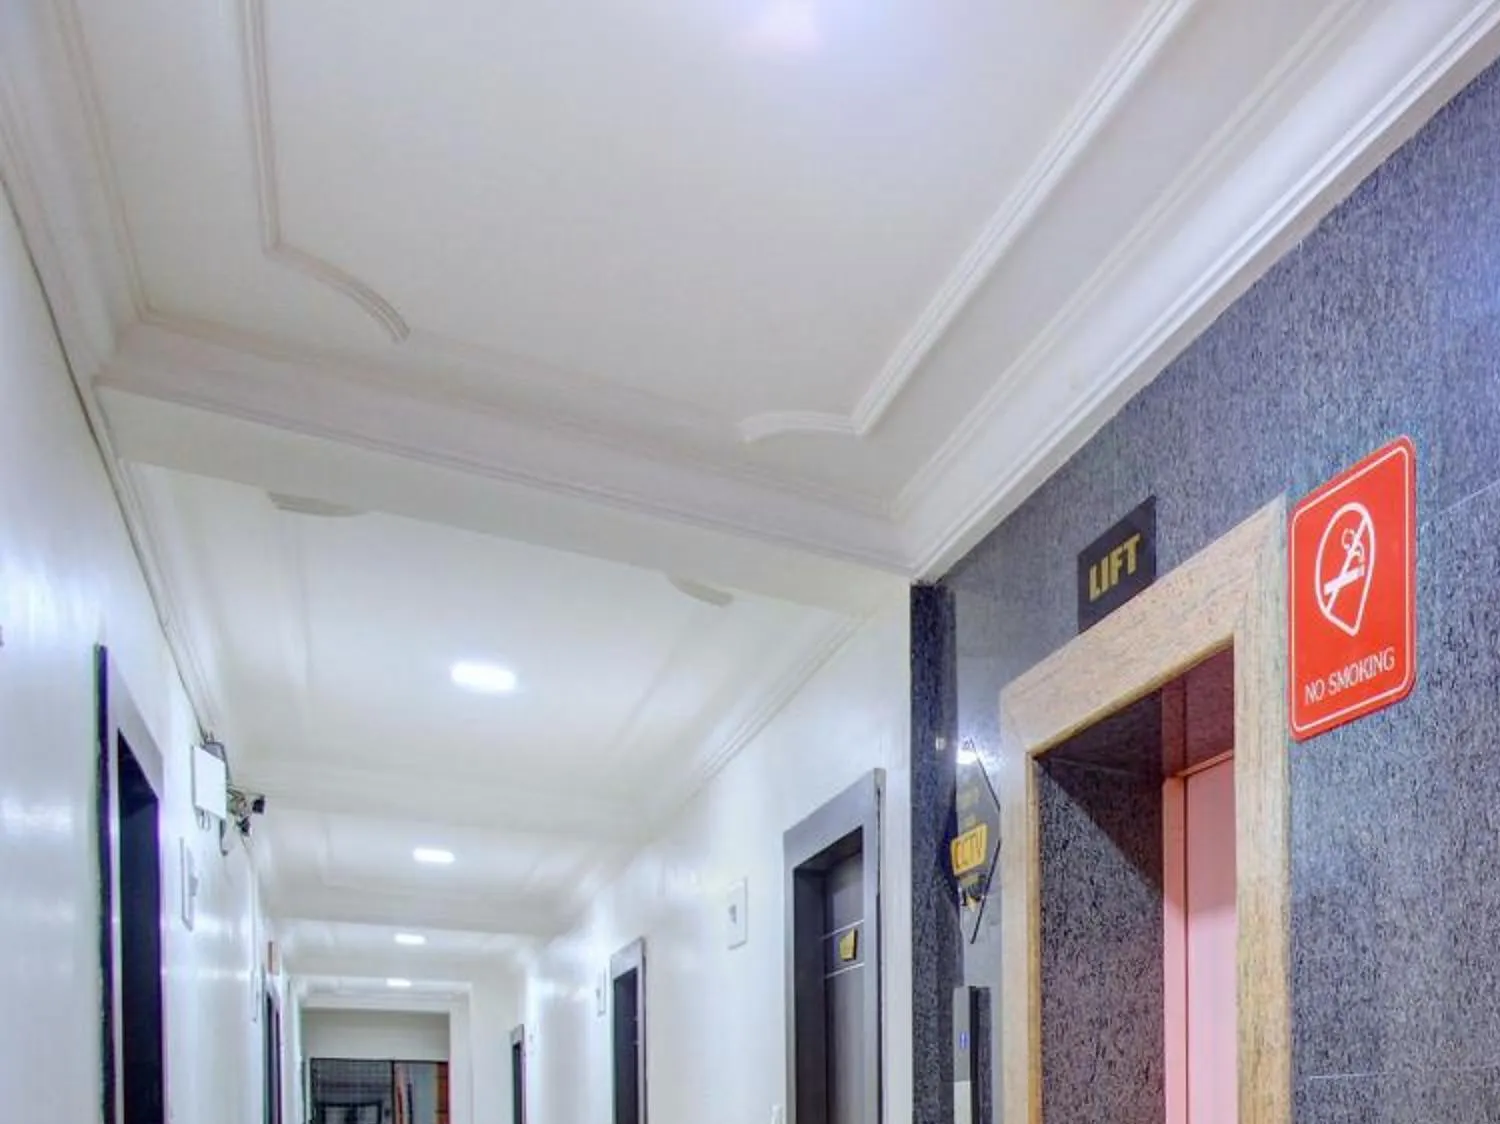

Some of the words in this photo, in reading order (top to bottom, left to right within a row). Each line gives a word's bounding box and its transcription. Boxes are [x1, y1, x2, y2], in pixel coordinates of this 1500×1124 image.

[1088, 532, 1140, 603] LIFT
[1304, 678, 1325, 706] NO
[1328, 645, 1395, 697] SMOKING
[954, 825, 984, 870] CCTV
